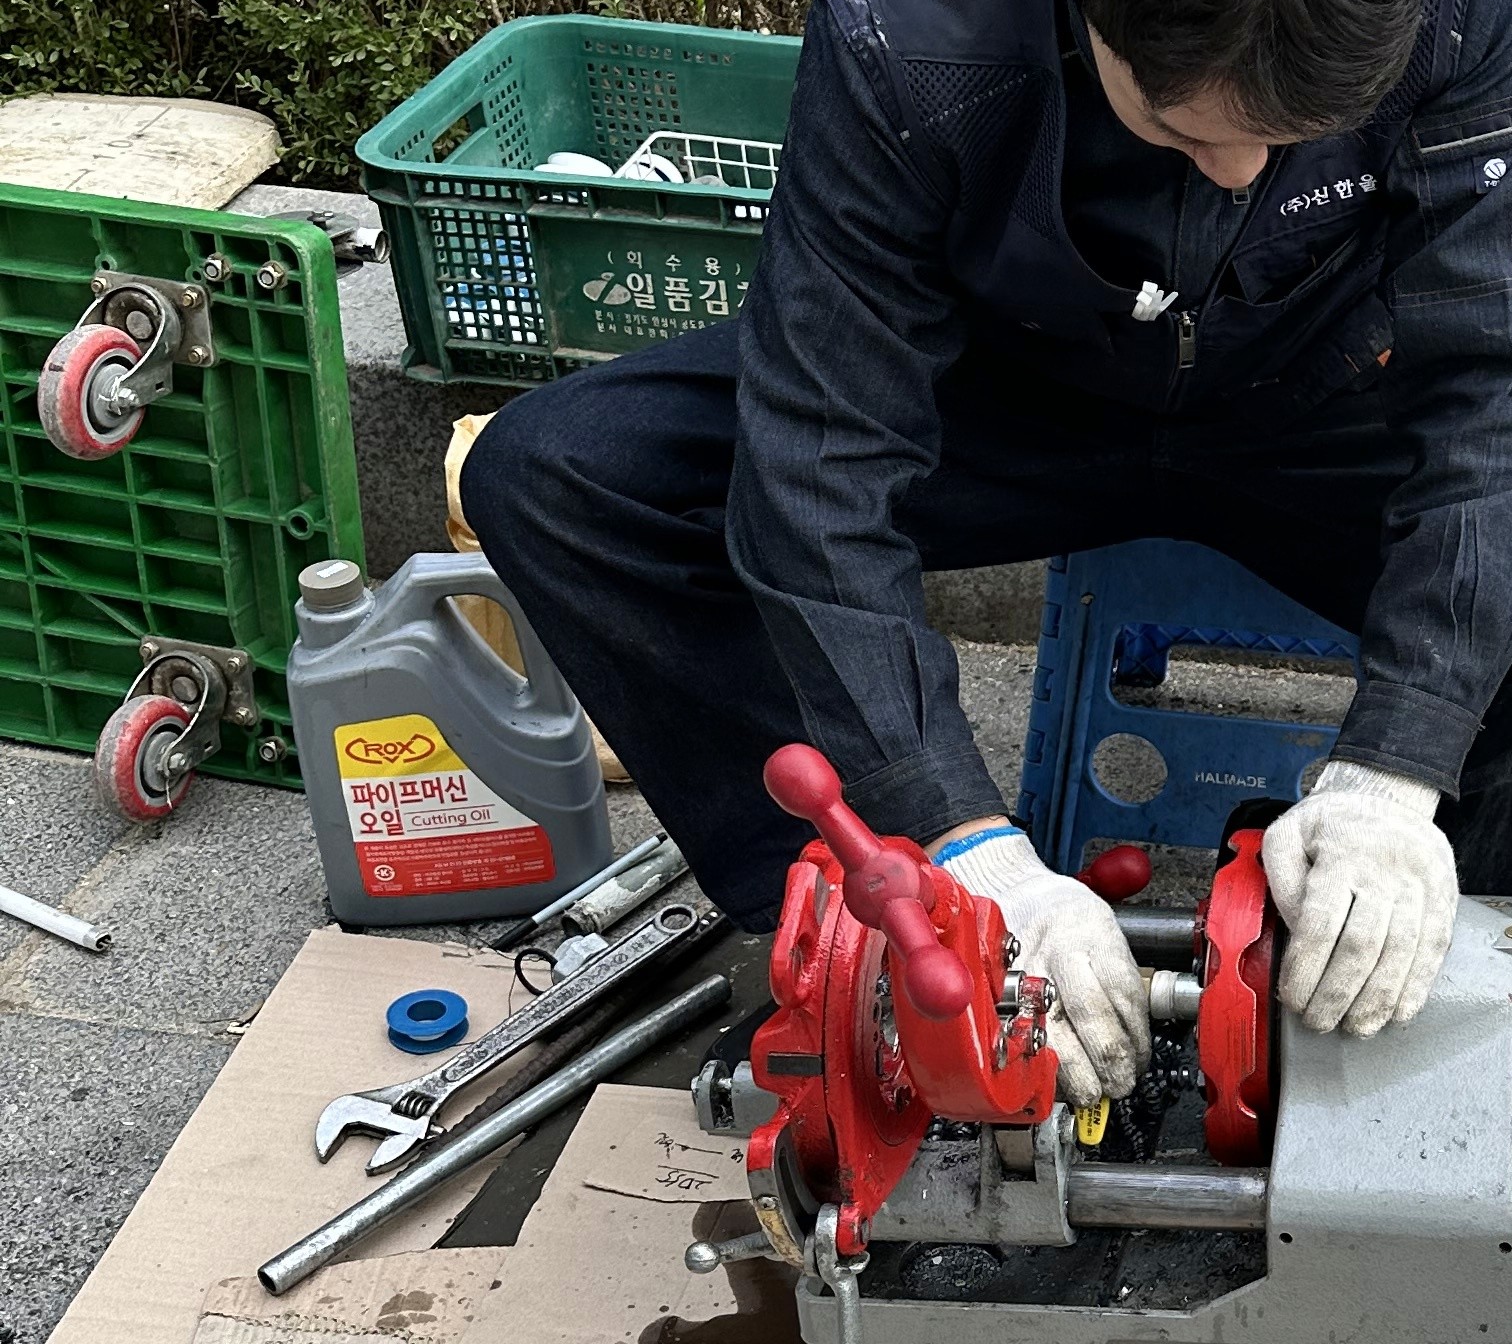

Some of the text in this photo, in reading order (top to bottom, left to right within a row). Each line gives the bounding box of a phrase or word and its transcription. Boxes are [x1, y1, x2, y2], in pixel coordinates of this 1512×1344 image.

[364, 739, 417, 757] ROX
[350, 774, 468, 809] 파이프머신
[360, 809, 405, 836] 오일
[411, 809, 491, 829] Cutting Oil
